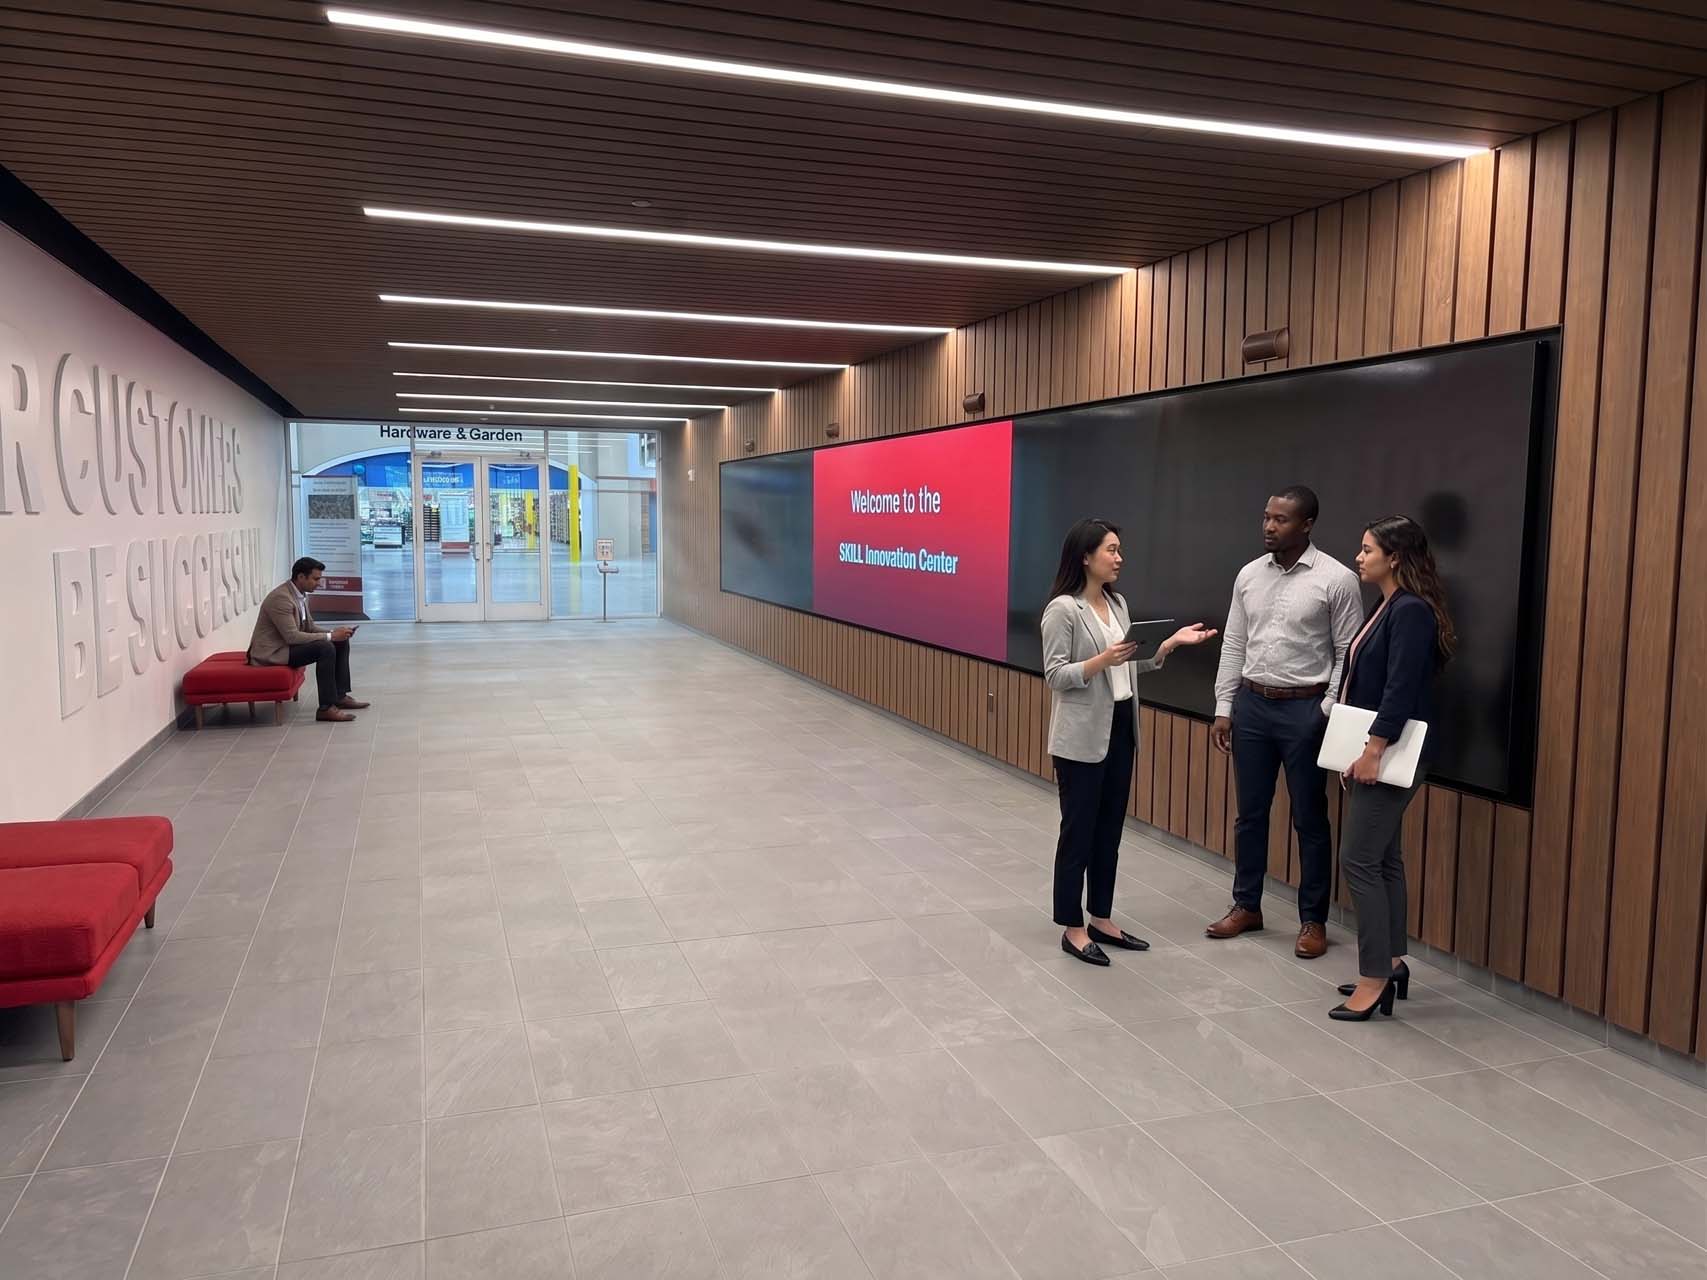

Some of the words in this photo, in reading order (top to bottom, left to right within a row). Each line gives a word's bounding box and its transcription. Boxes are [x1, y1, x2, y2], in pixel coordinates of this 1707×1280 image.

[53, 353, 244, 515] CUSTOMERS
[380, 425, 451, 439] Hardware
[456, 427, 467, 440] &
[470, 428, 522, 441] Garden
[850, 489, 900, 514] Welcome
[903, 488, 915, 514] to
[919, 485, 941, 514] the
[839, 542, 863, 564] SKILL
[865, 544, 916, 570] Innovation
[918, 548, 958, 574] Center
[53, 545, 122, 720] BE
